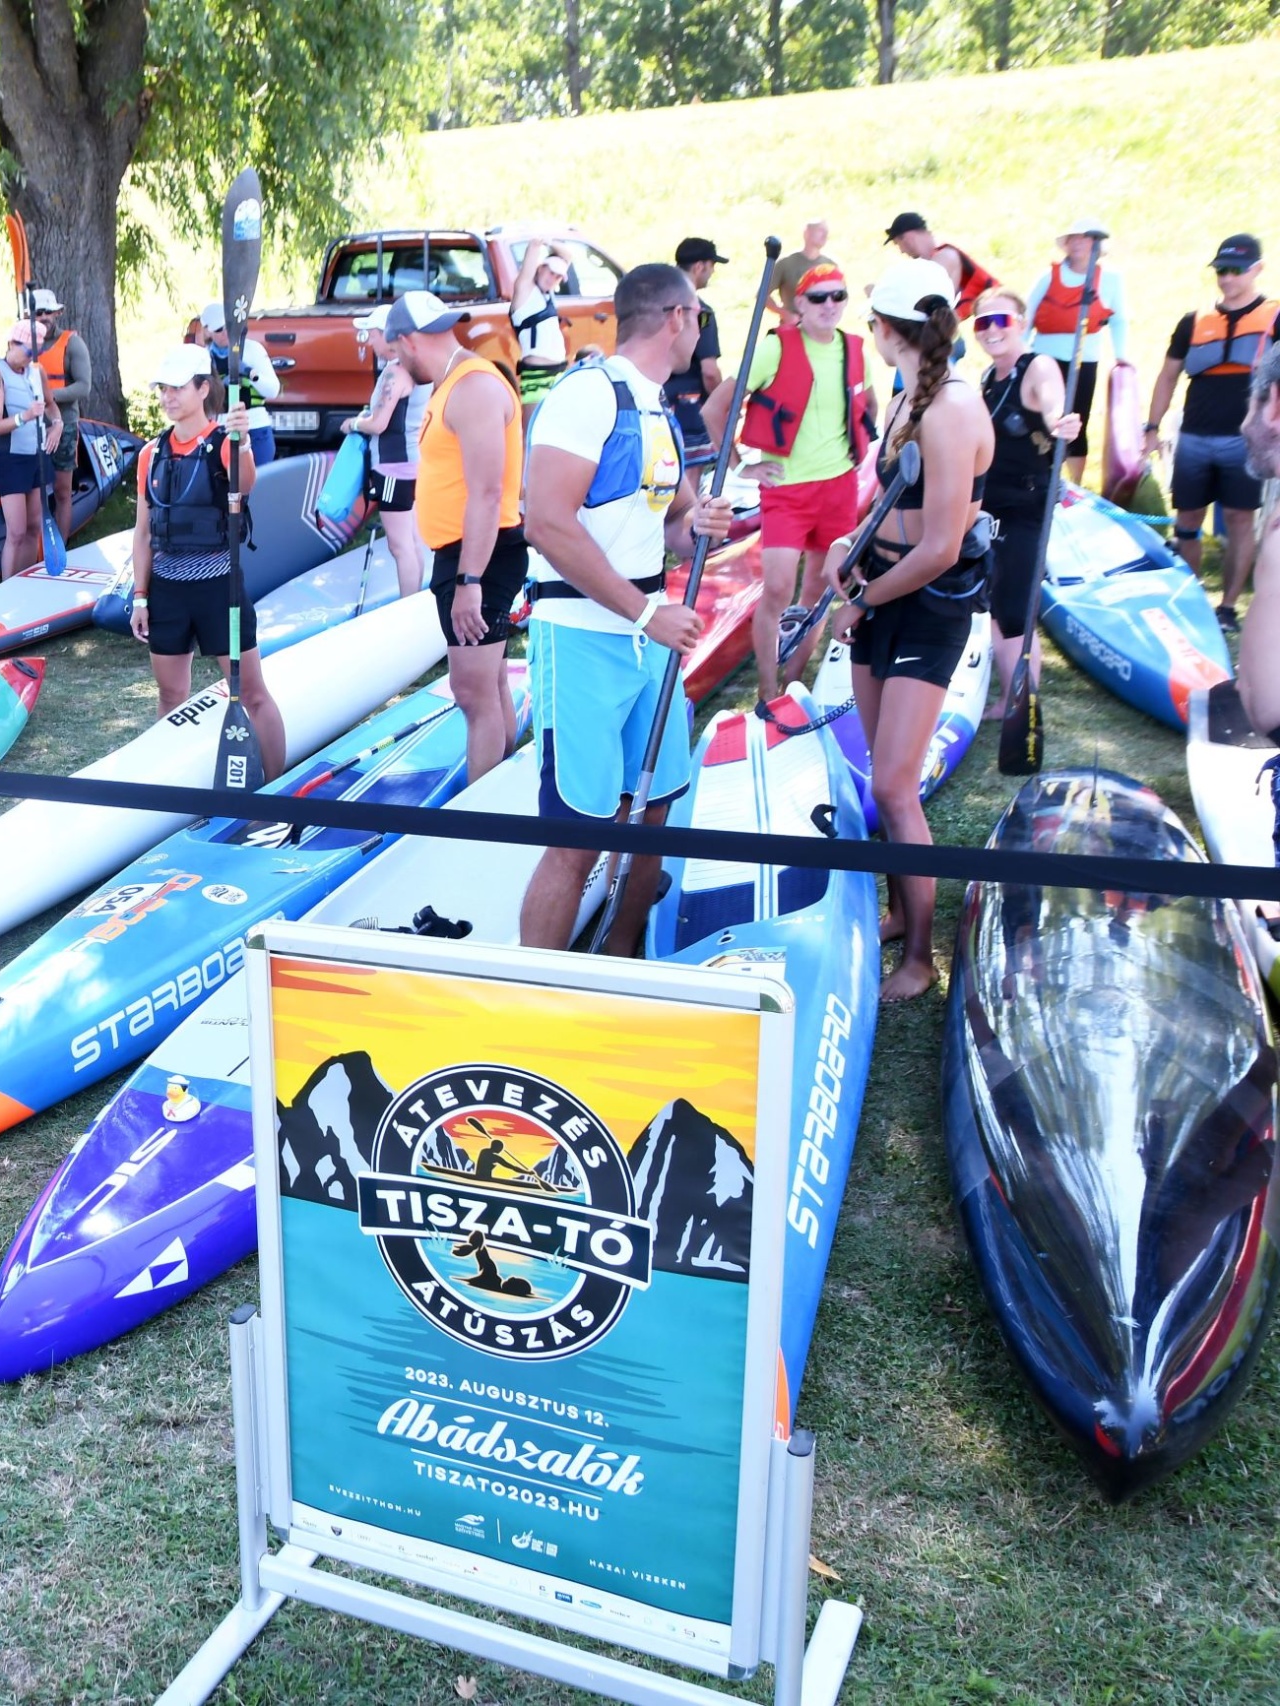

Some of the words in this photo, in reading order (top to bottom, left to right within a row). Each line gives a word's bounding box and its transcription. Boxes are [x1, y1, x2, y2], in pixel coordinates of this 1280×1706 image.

[166, 695, 218, 727] epic
[228, 760, 245, 785] 201
[392, 1078, 609, 1170] ÁTEVEZÉS
[375, 1189, 635, 1266] TISZA-TÓ
[411, 1279, 595, 1349] ÁTÚSZÁS
[404, 1366, 454, 1389] 2023.
[459, 1379, 579, 1421] AUGUSZTUS
[584, 1409, 610, 1428] 12.
[376, 1397, 645, 1497] Abádszalók
[413, 1460, 600, 1521] TISZATO2023.HU
[589, 1558, 626, 1575] HAZAI
[631, 1570, 687, 1590] VIZEKEN
